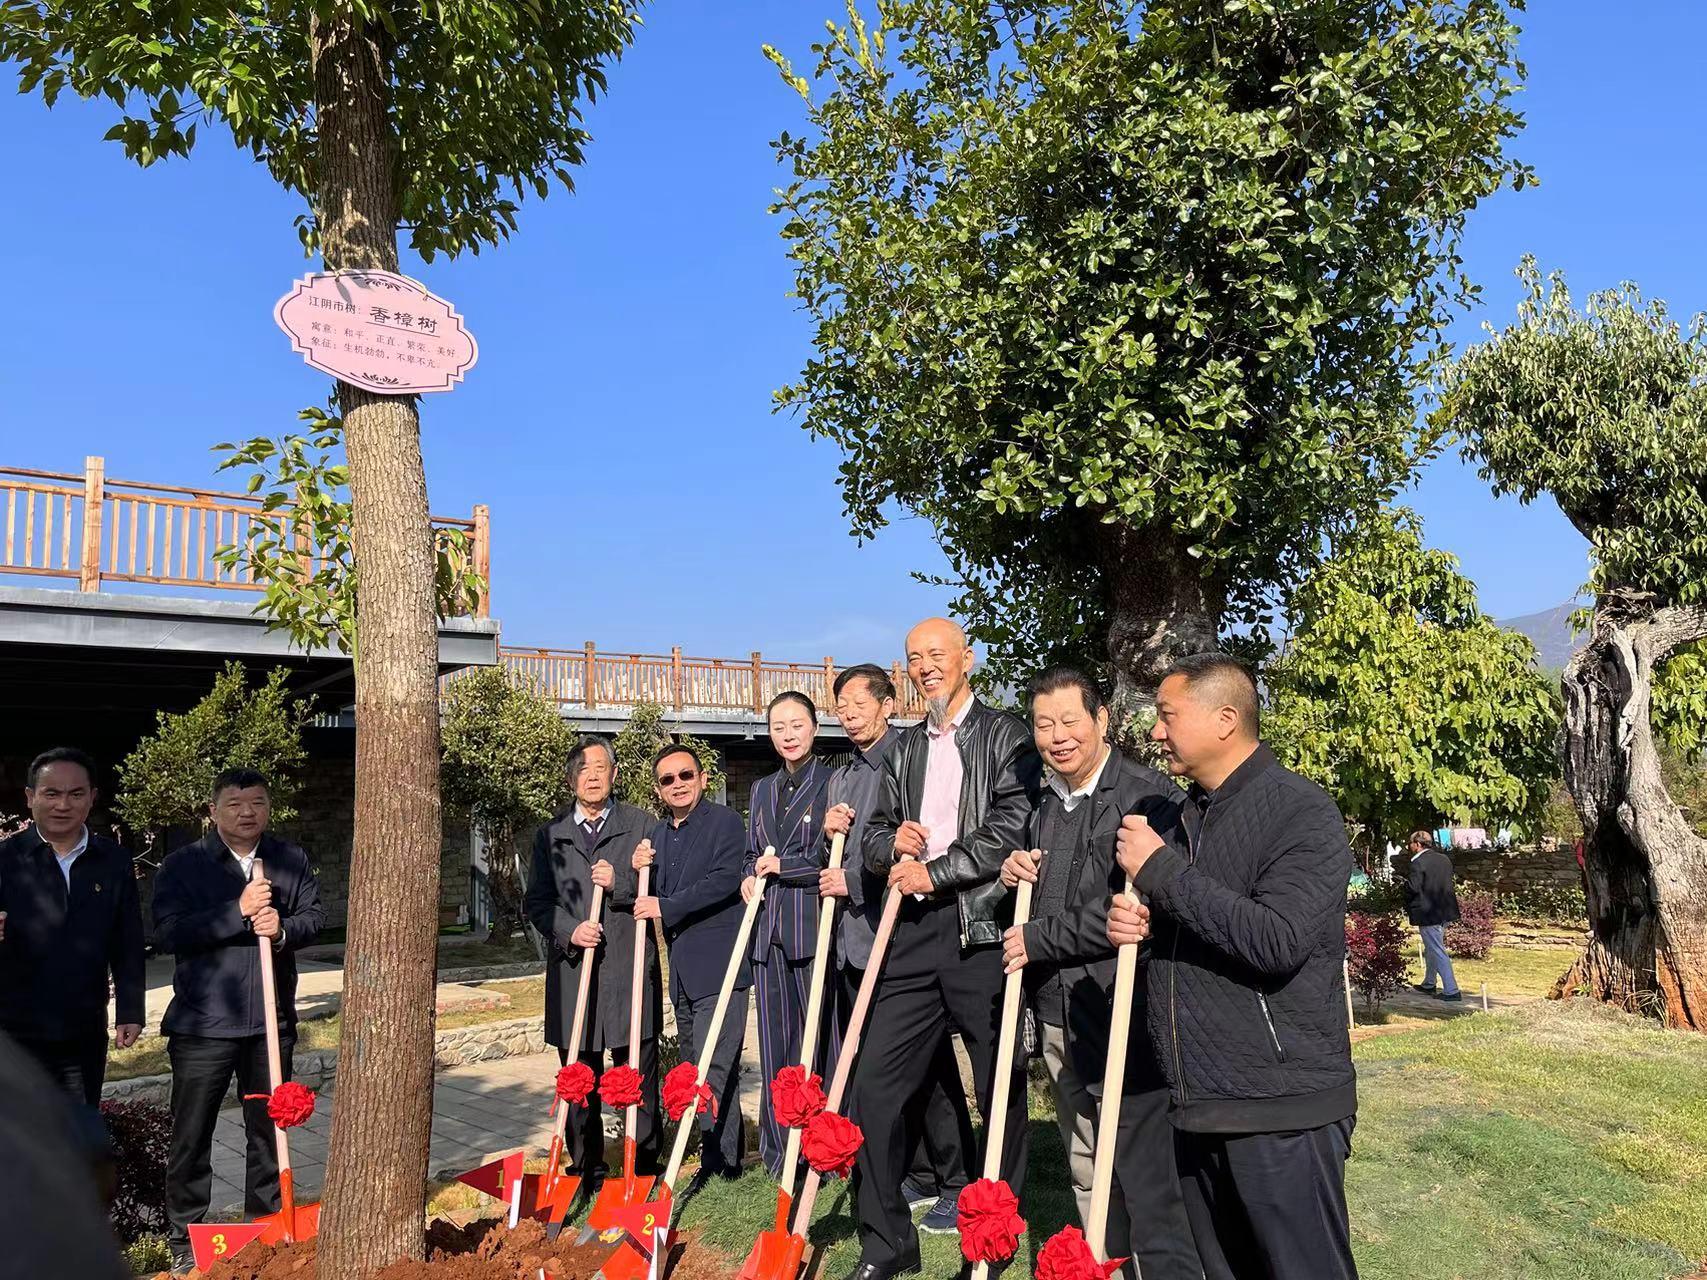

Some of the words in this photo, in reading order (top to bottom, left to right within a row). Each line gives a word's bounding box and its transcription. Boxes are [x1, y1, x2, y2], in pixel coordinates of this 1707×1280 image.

[369, 306, 438, 334] 香樟树
[496, 1169, 505, 1188] 1
[642, 1213, 655, 1236] 2
[211, 1233, 228, 1255] 3
